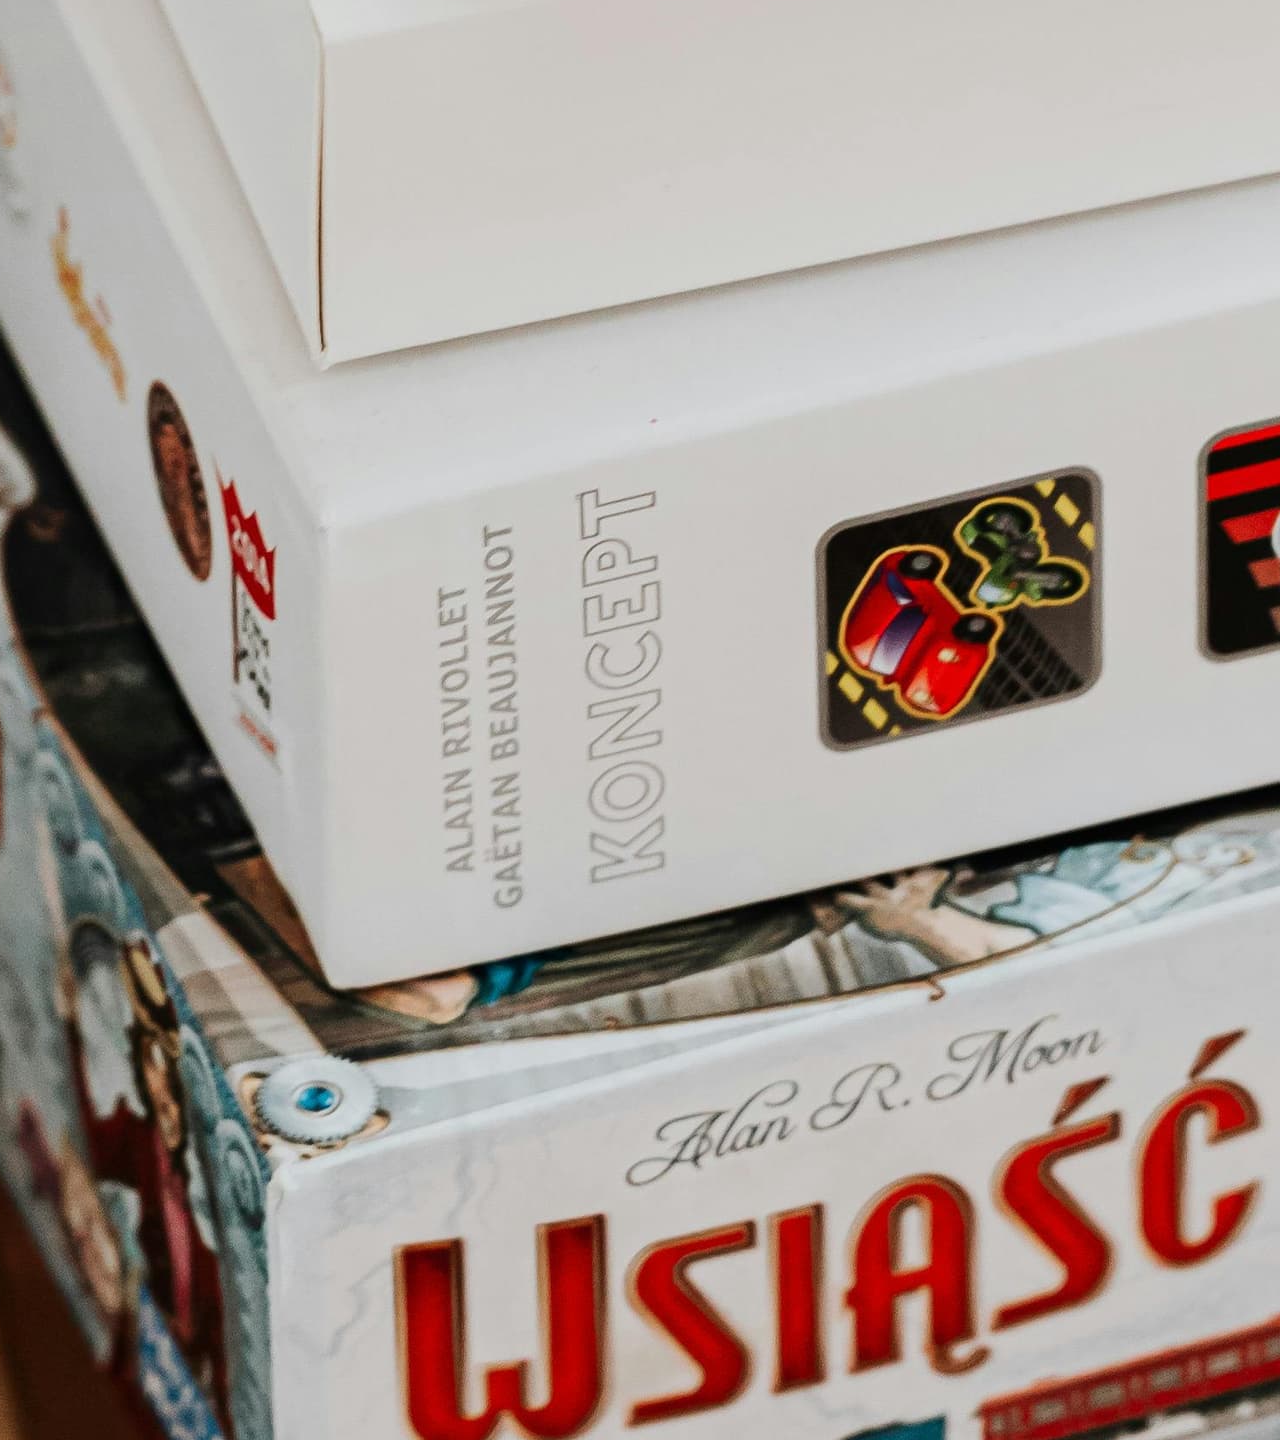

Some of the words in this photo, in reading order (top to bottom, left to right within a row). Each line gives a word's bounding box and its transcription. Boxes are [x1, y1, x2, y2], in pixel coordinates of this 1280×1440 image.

[437, 584, 473, 761] RIVOLLET
[481, 522, 521, 763] BEAUJANNOT
[575, 487, 667, 886] KONCEPT
[444, 766, 475, 875] ALAIN
[484, 768, 524, 910] GAËTAN
[625, 1078, 800, 1187] Alan
[809, 1062, 911, 1132] R.
[926, 1013, 1108, 1101] Moon
